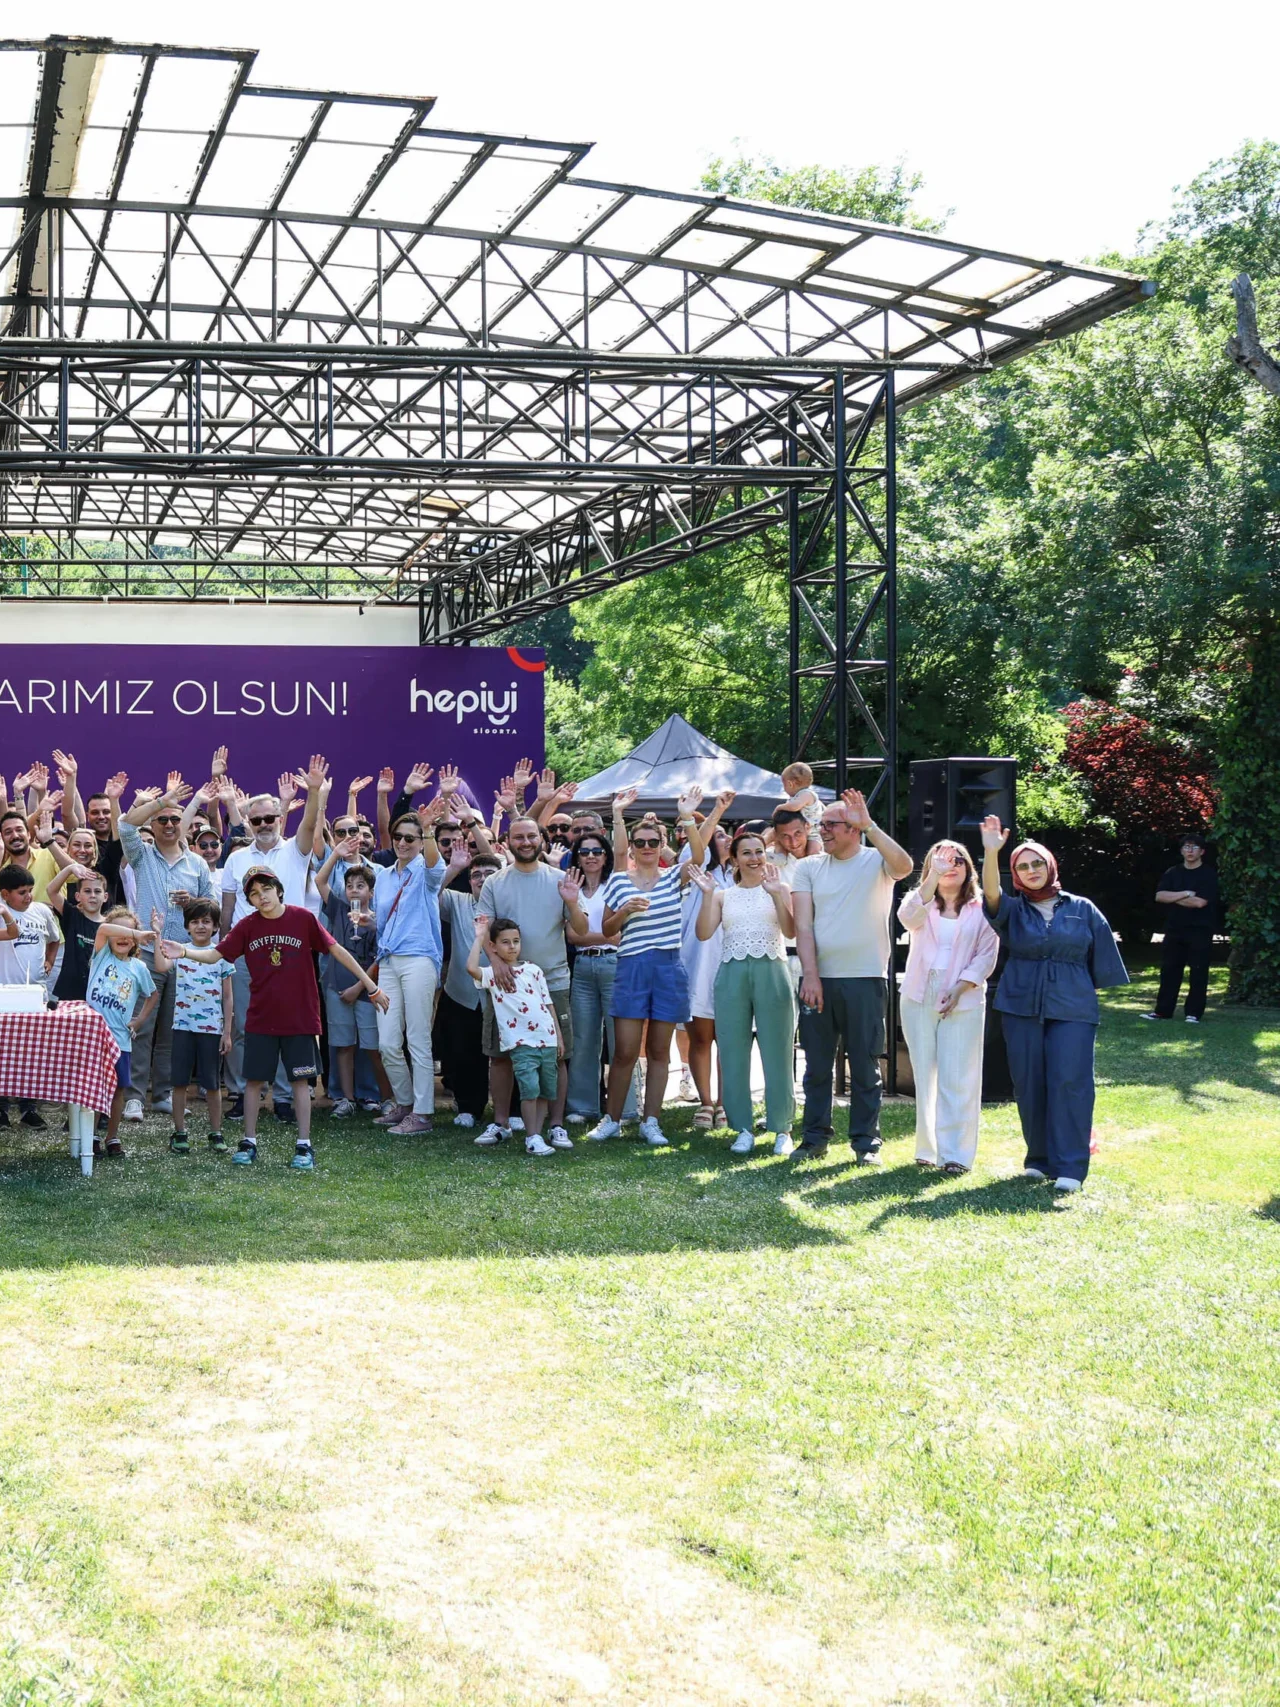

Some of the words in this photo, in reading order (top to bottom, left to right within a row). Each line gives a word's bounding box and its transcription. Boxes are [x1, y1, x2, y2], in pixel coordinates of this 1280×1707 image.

[172, 680, 348, 715] OLSUN!
[410, 677, 518, 726] hepiyi
[248, 935, 302, 951] GRYFFINDOR
[91, 988, 127, 1014] Explore
